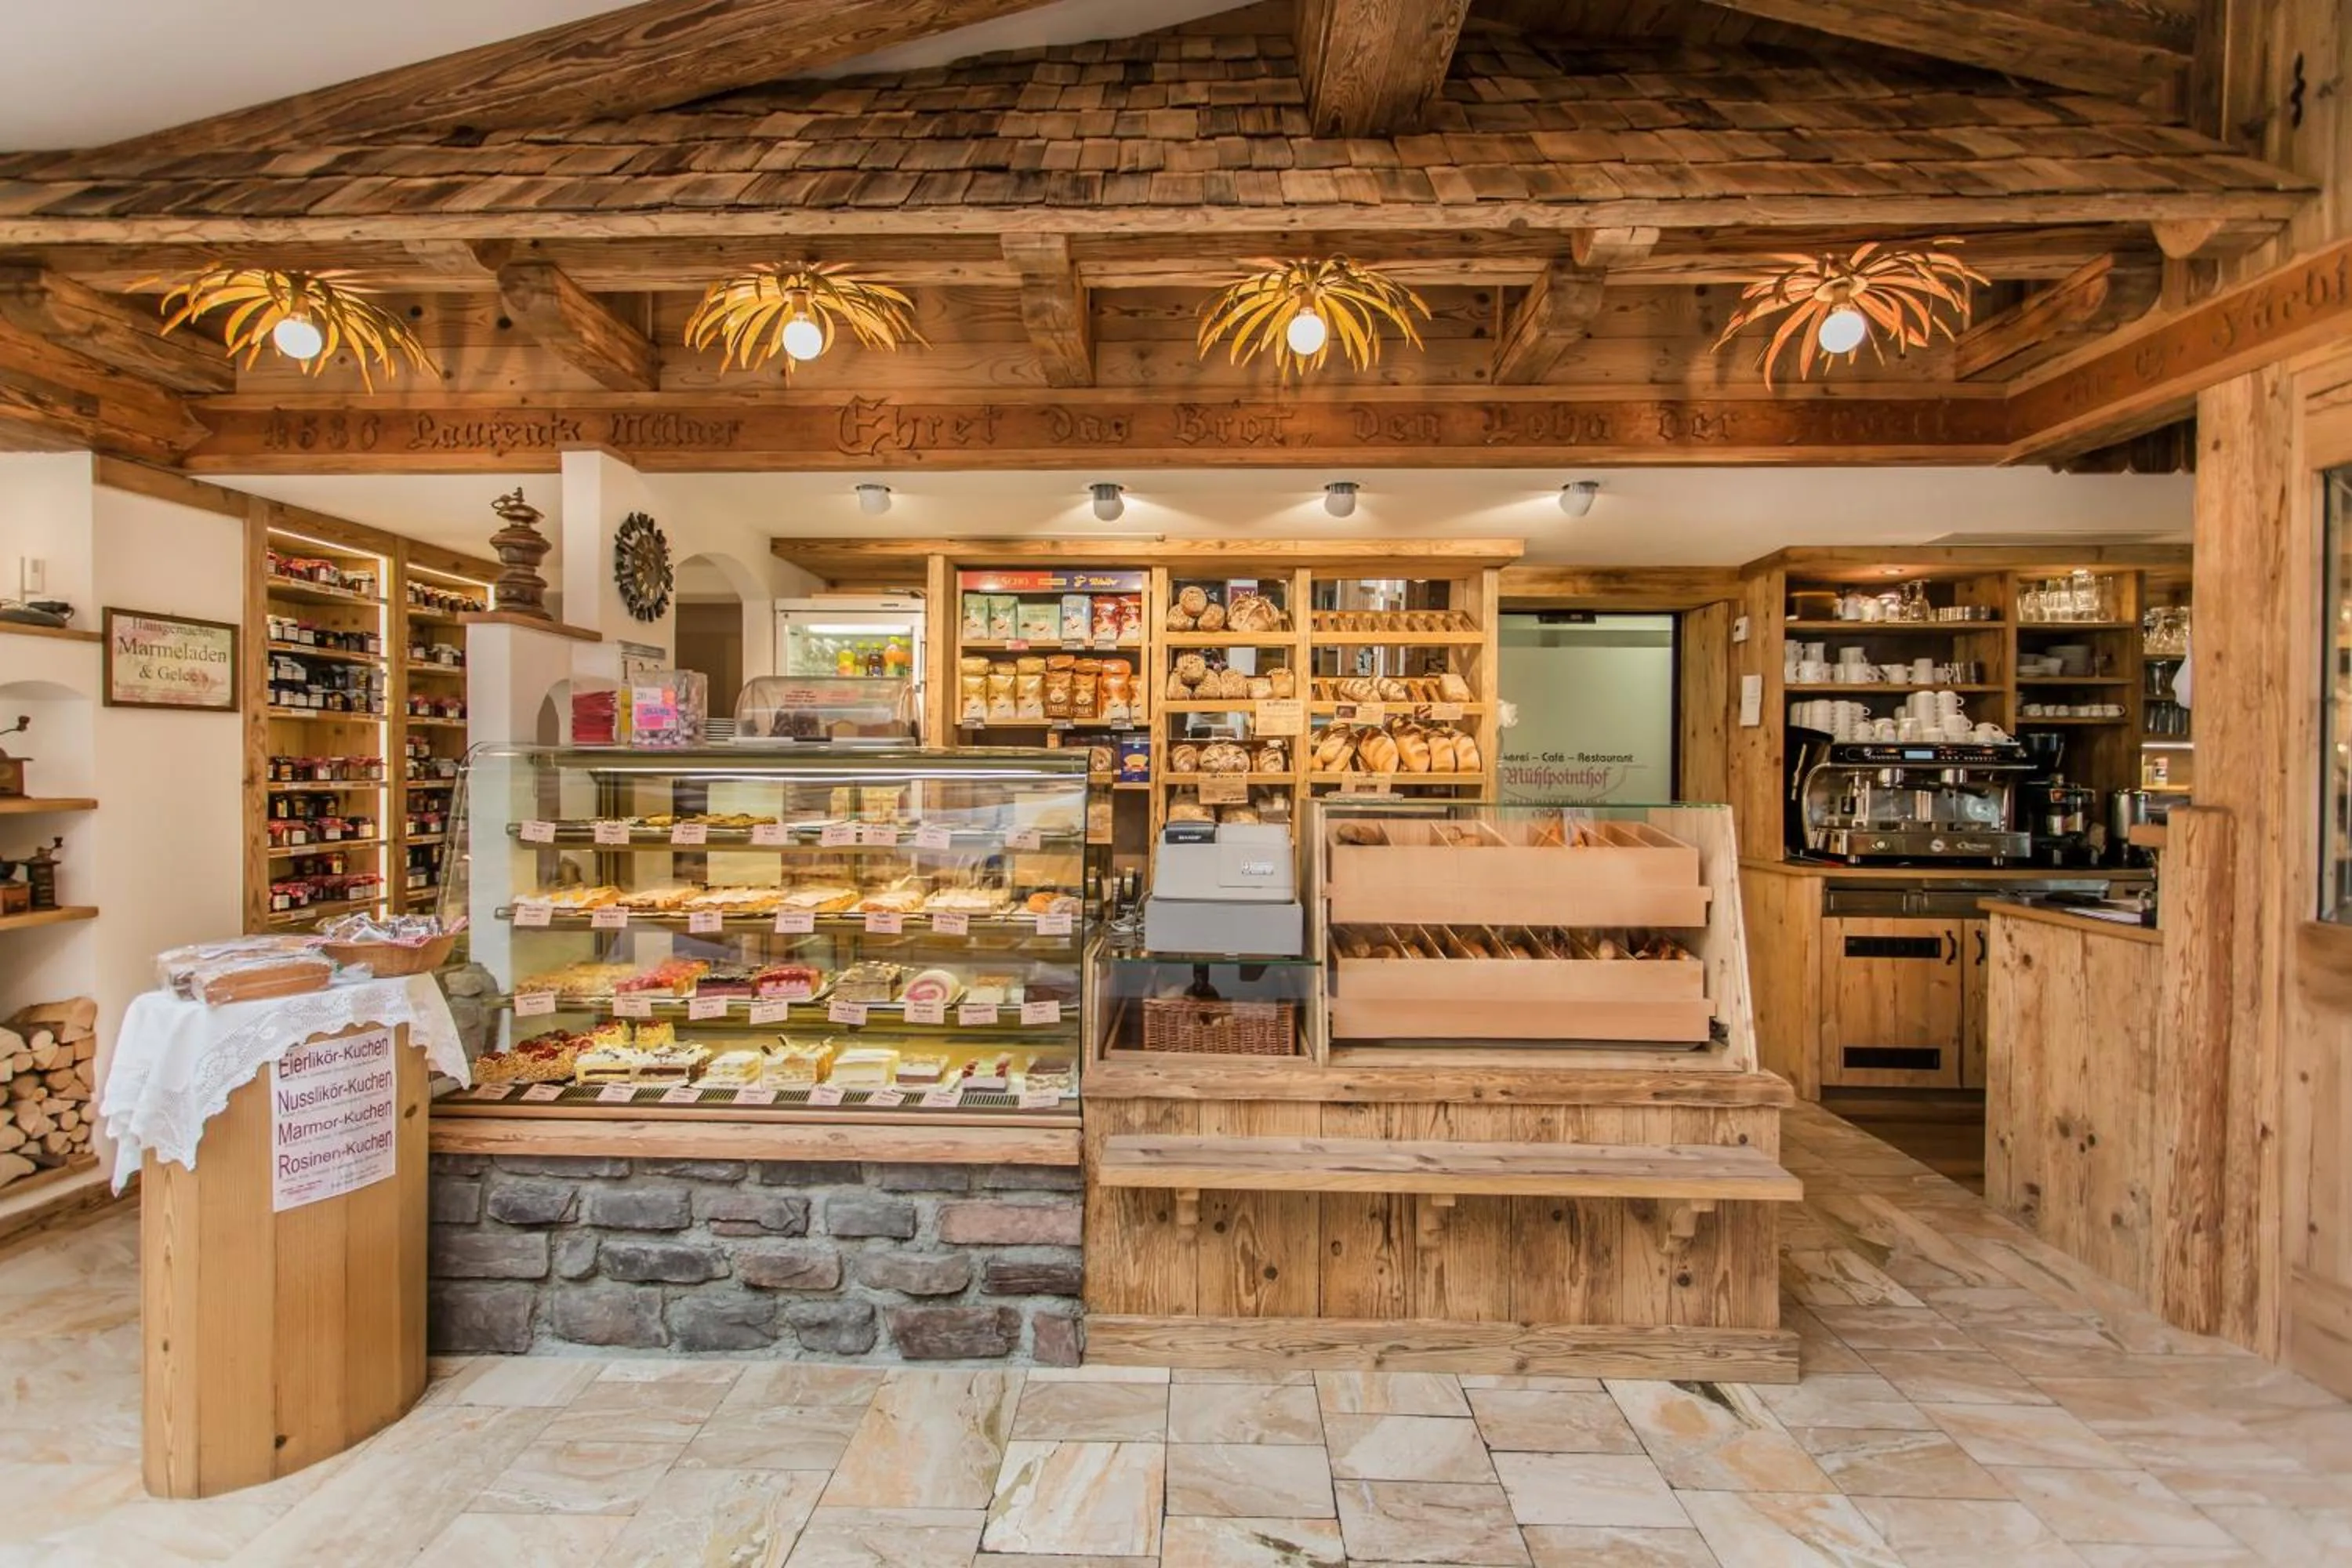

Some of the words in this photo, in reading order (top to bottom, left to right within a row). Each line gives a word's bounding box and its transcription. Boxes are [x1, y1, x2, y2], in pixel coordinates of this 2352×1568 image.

[833, 394, 1004, 457] Ehret
[118, 636, 227, 663] Marmeladen
[139, 664, 153, 680] &
[1577, 752, 1634, 764] Restaurant
[278, 1036, 389, 1080] Eierlikör-Kuchen
[278, 1070, 393, 1116] Nusslikör-Kuchen
[278, 1100, 393, 1145] Marmor-Kuchen
[278, 1130, 393, 1178] Rosinen-Kuchen
